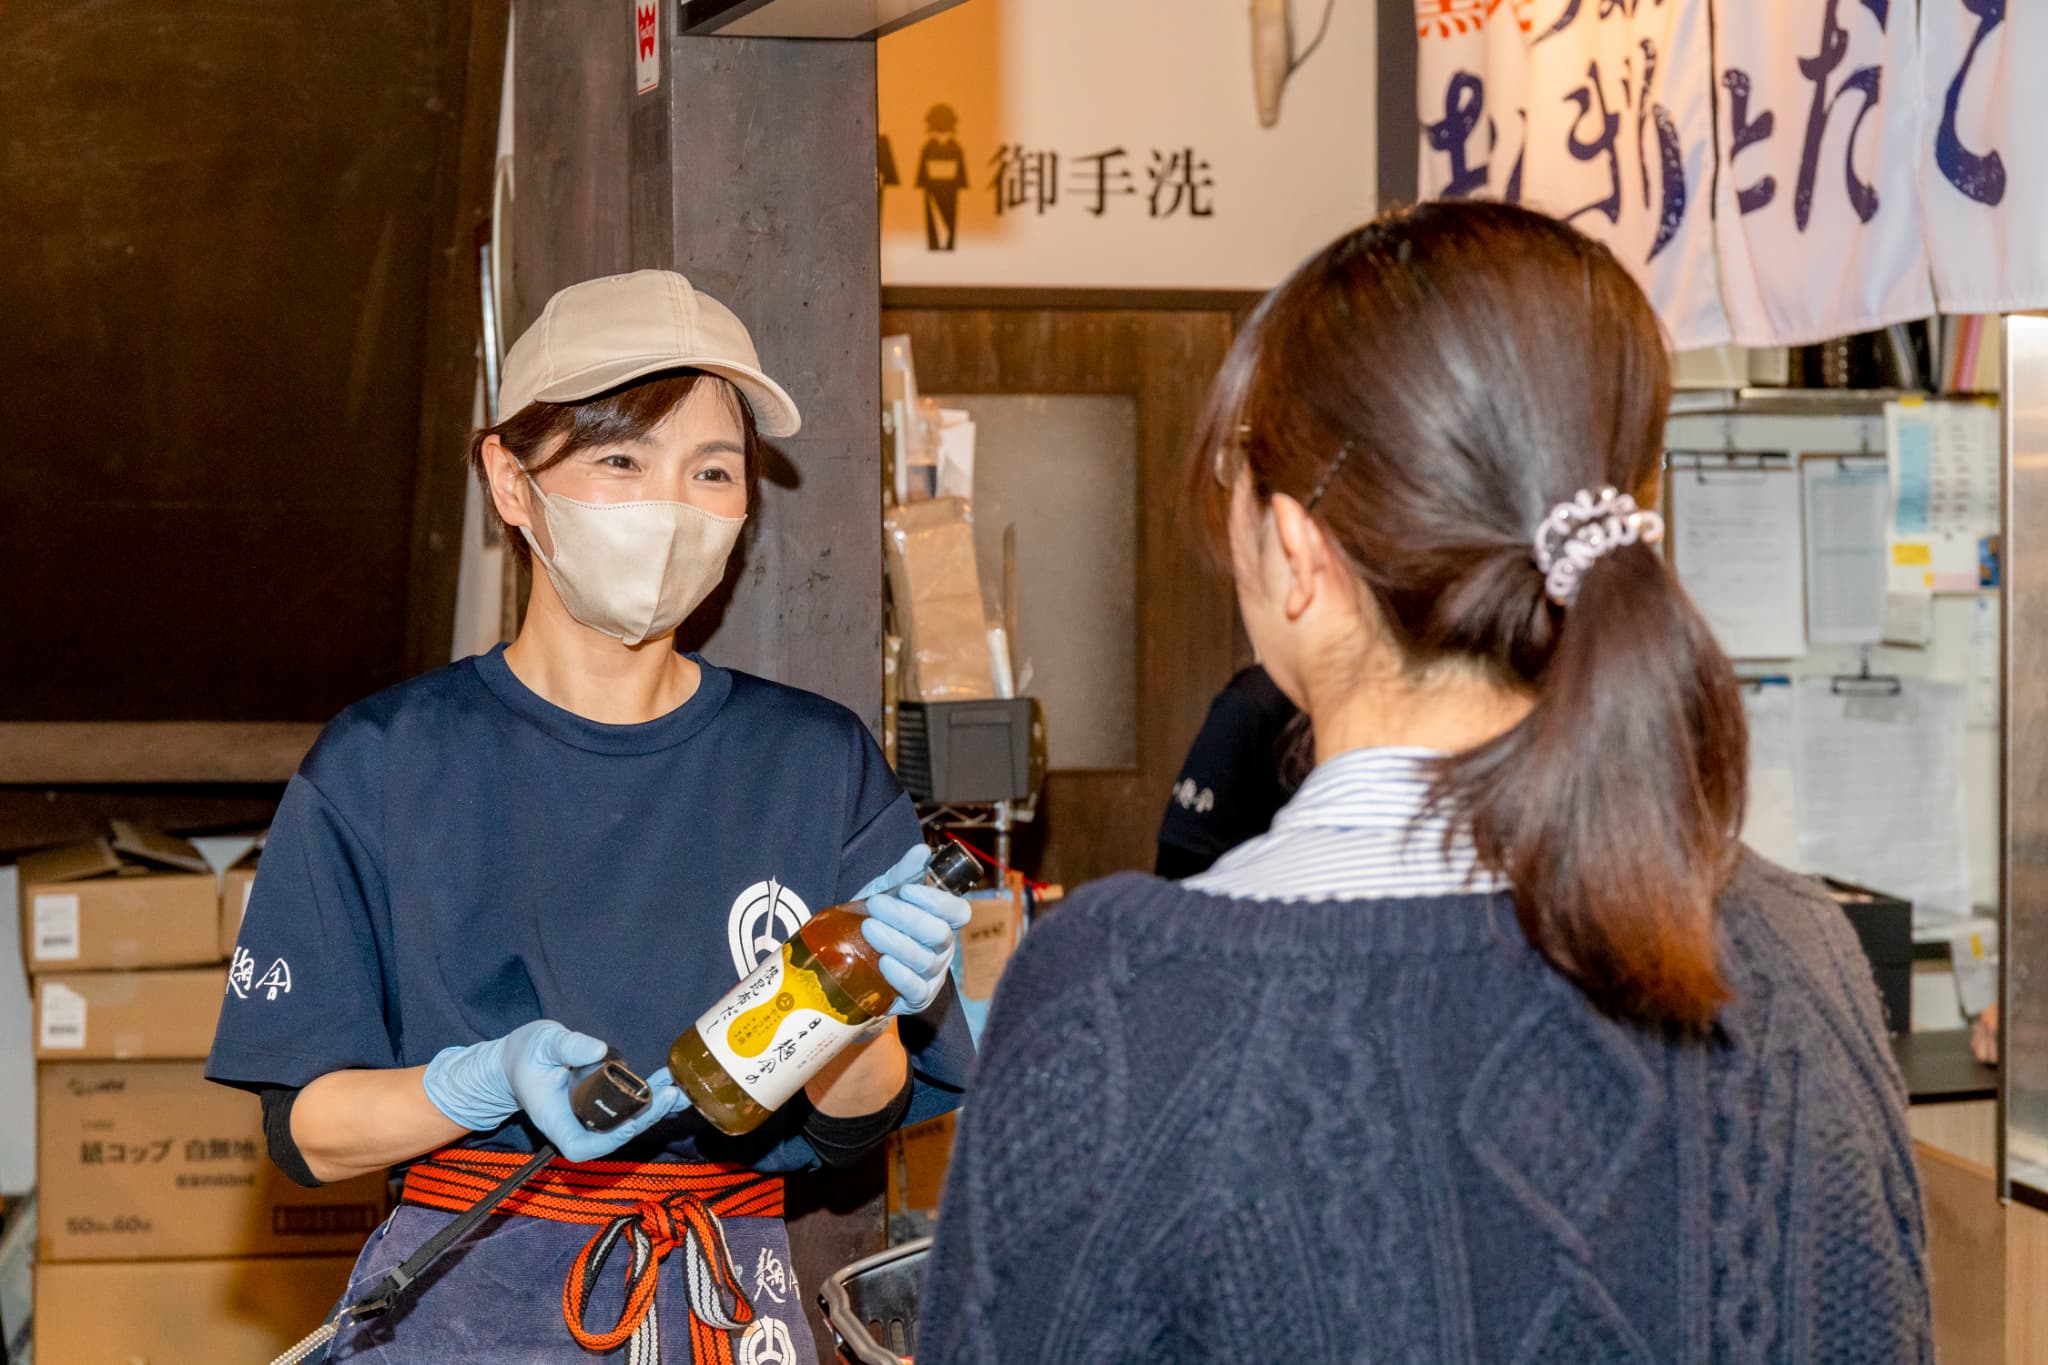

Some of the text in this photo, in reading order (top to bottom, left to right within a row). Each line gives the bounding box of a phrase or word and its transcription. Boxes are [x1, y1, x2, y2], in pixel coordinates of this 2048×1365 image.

[986, 143, 1215, 218] 御手洗
[706, 965, 779, 1034] 根昆布だし
